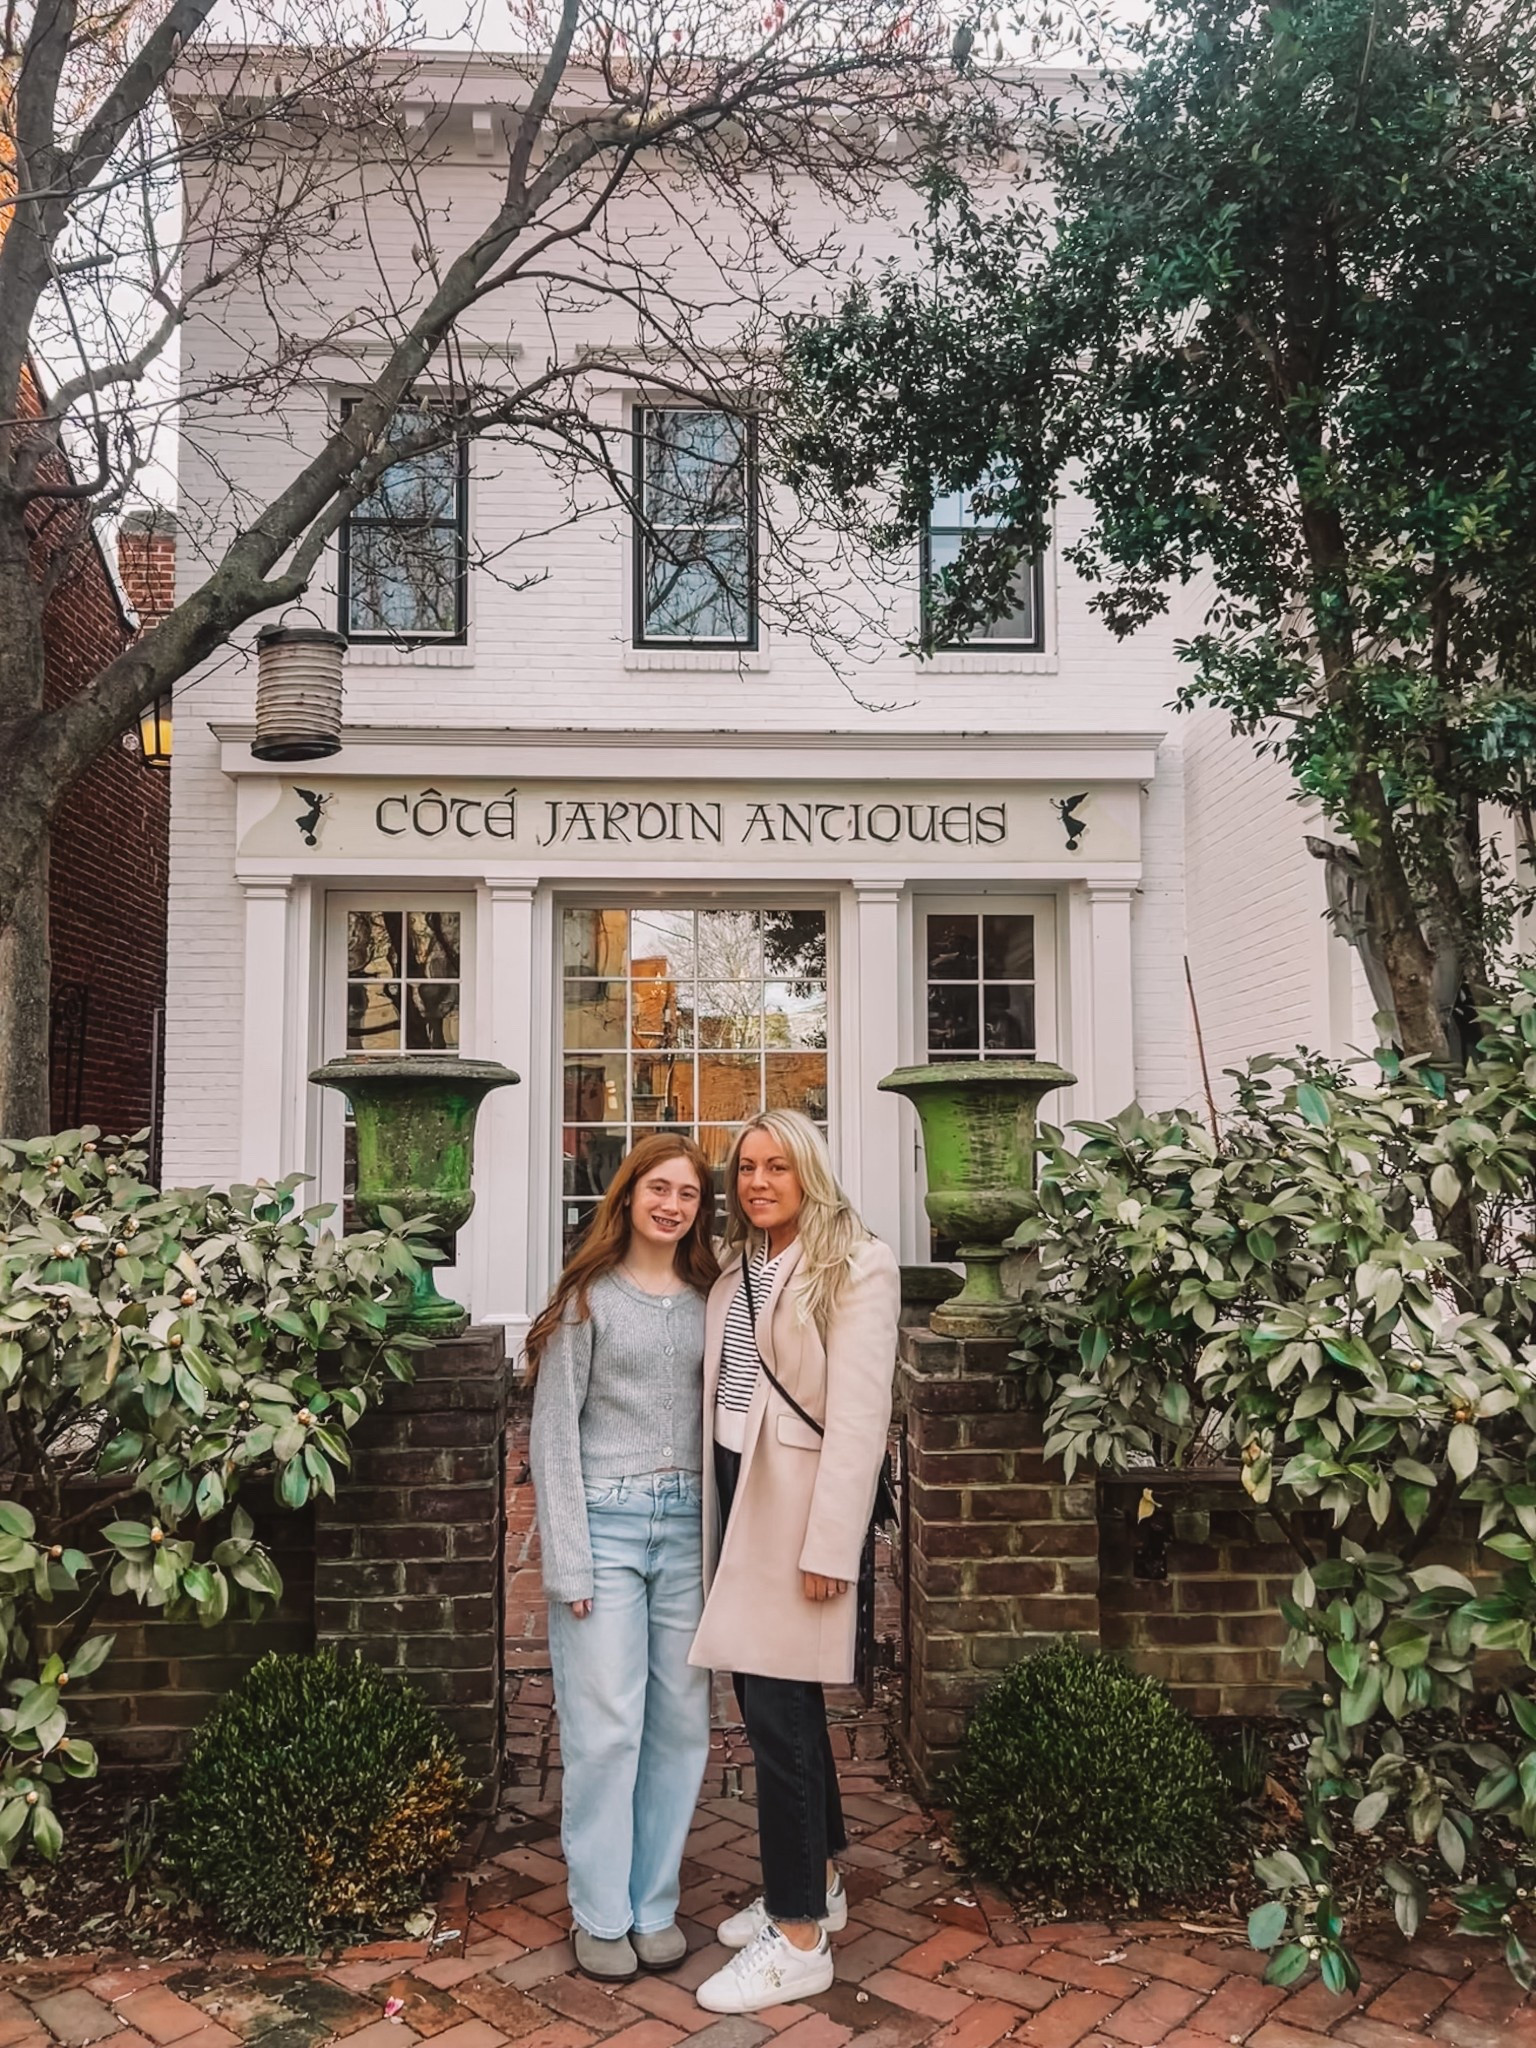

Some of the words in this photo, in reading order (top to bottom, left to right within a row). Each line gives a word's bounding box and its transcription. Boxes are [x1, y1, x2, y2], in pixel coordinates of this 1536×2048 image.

[376, 787, 518, 840] CÔTÉ
[542, 801, 721, 847] JARDIN
[741, 801, 1006, 845] ANTIQUES
